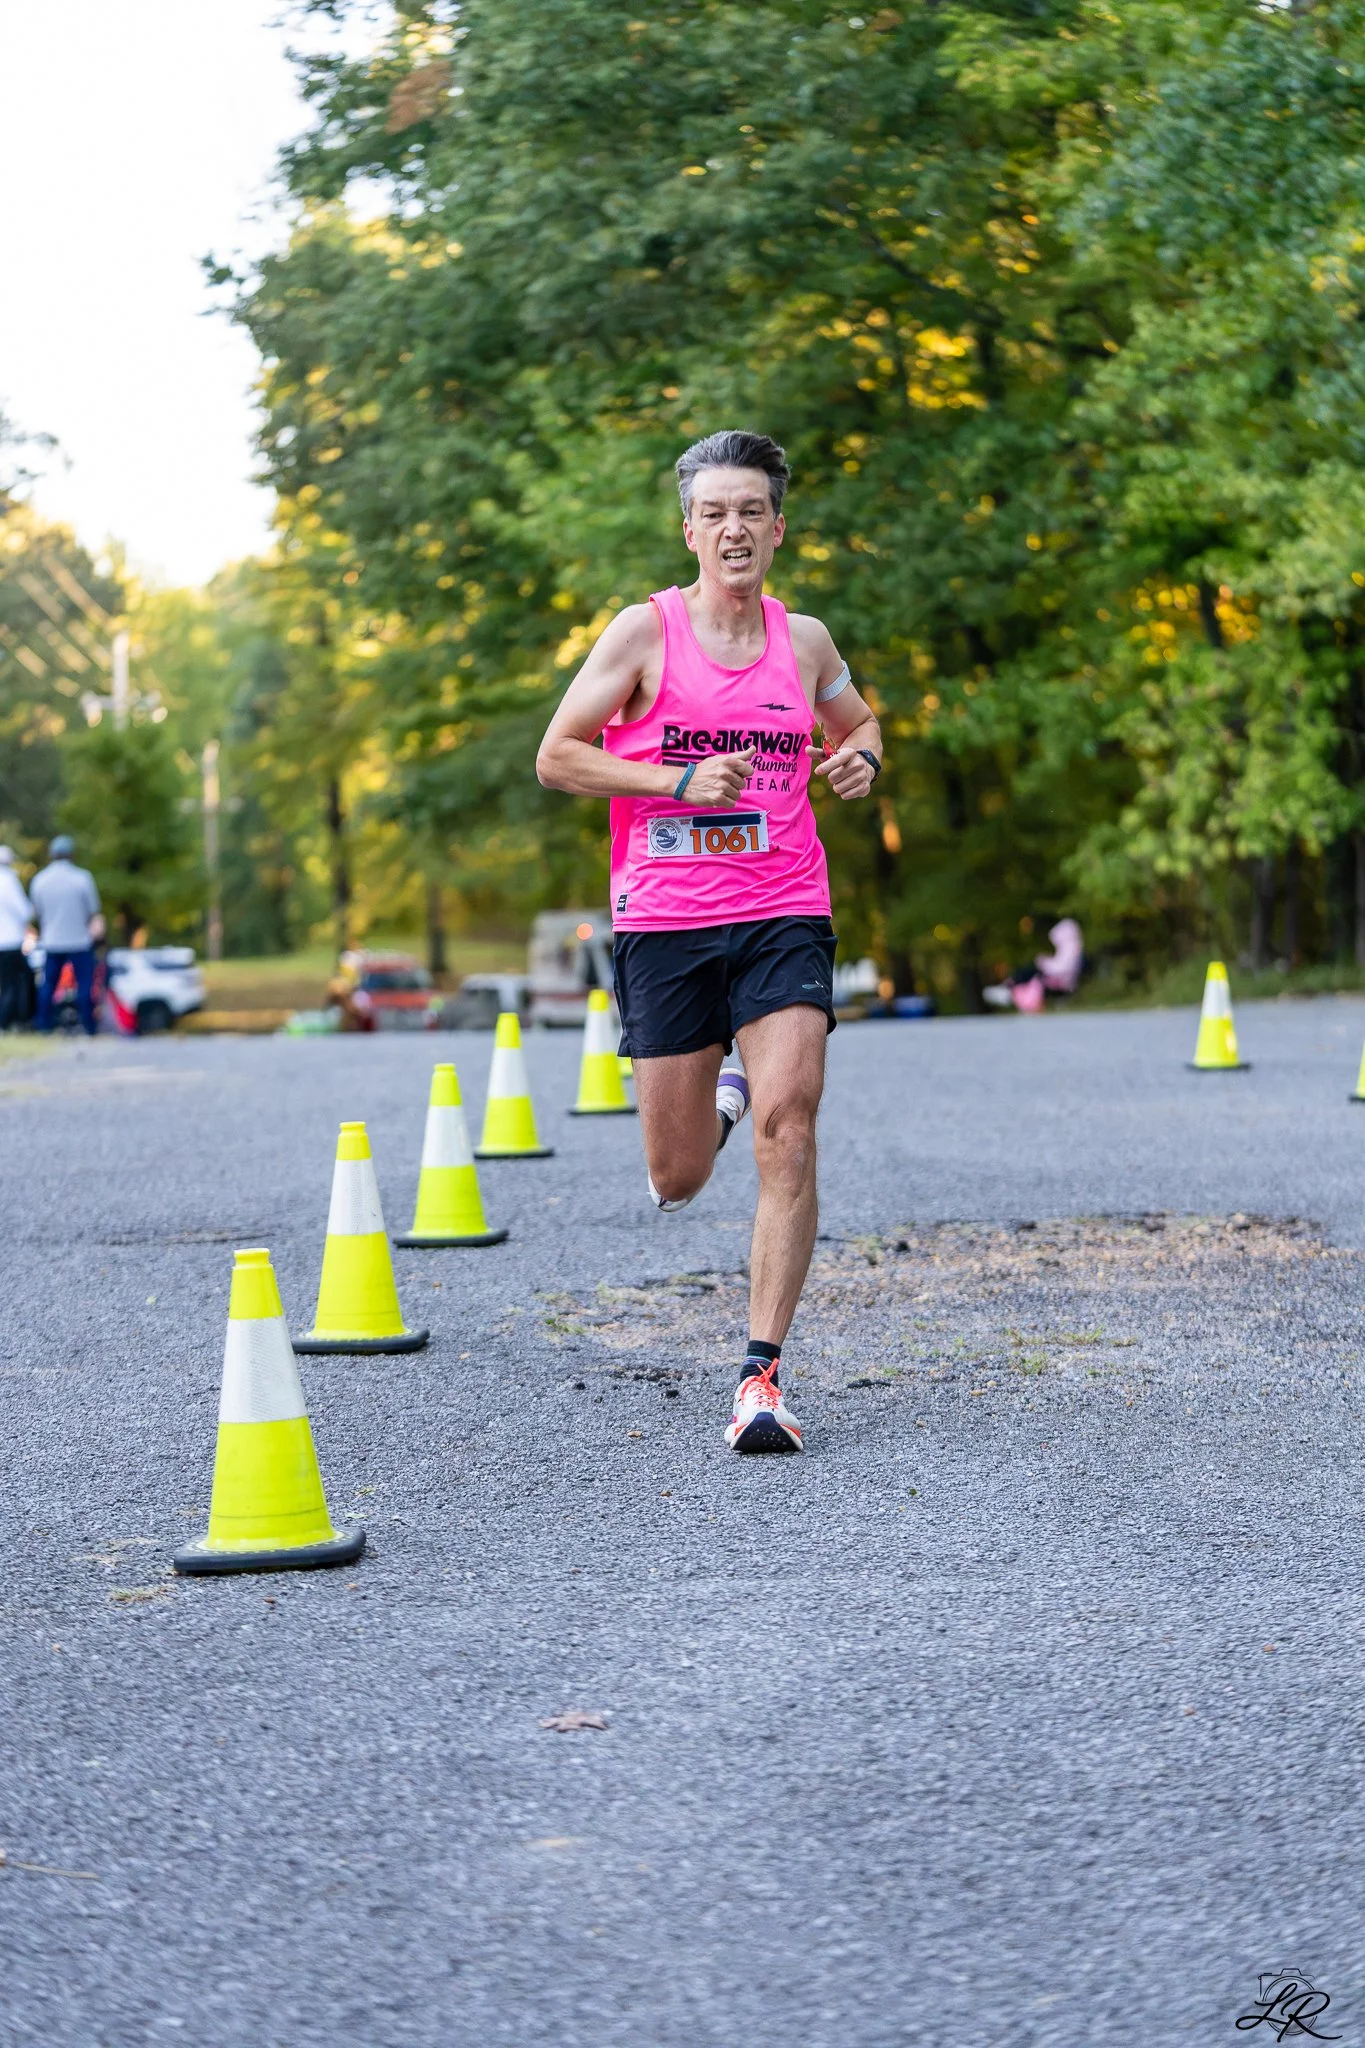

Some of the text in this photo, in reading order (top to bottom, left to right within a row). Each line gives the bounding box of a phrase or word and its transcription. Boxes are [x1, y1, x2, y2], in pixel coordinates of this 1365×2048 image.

[662, 725, 807, 761] Breakaway
[751, 755, 798, 777] Running
[746, 777, 791, 792] TEAM
[690, 826, 760, 854] 1061
